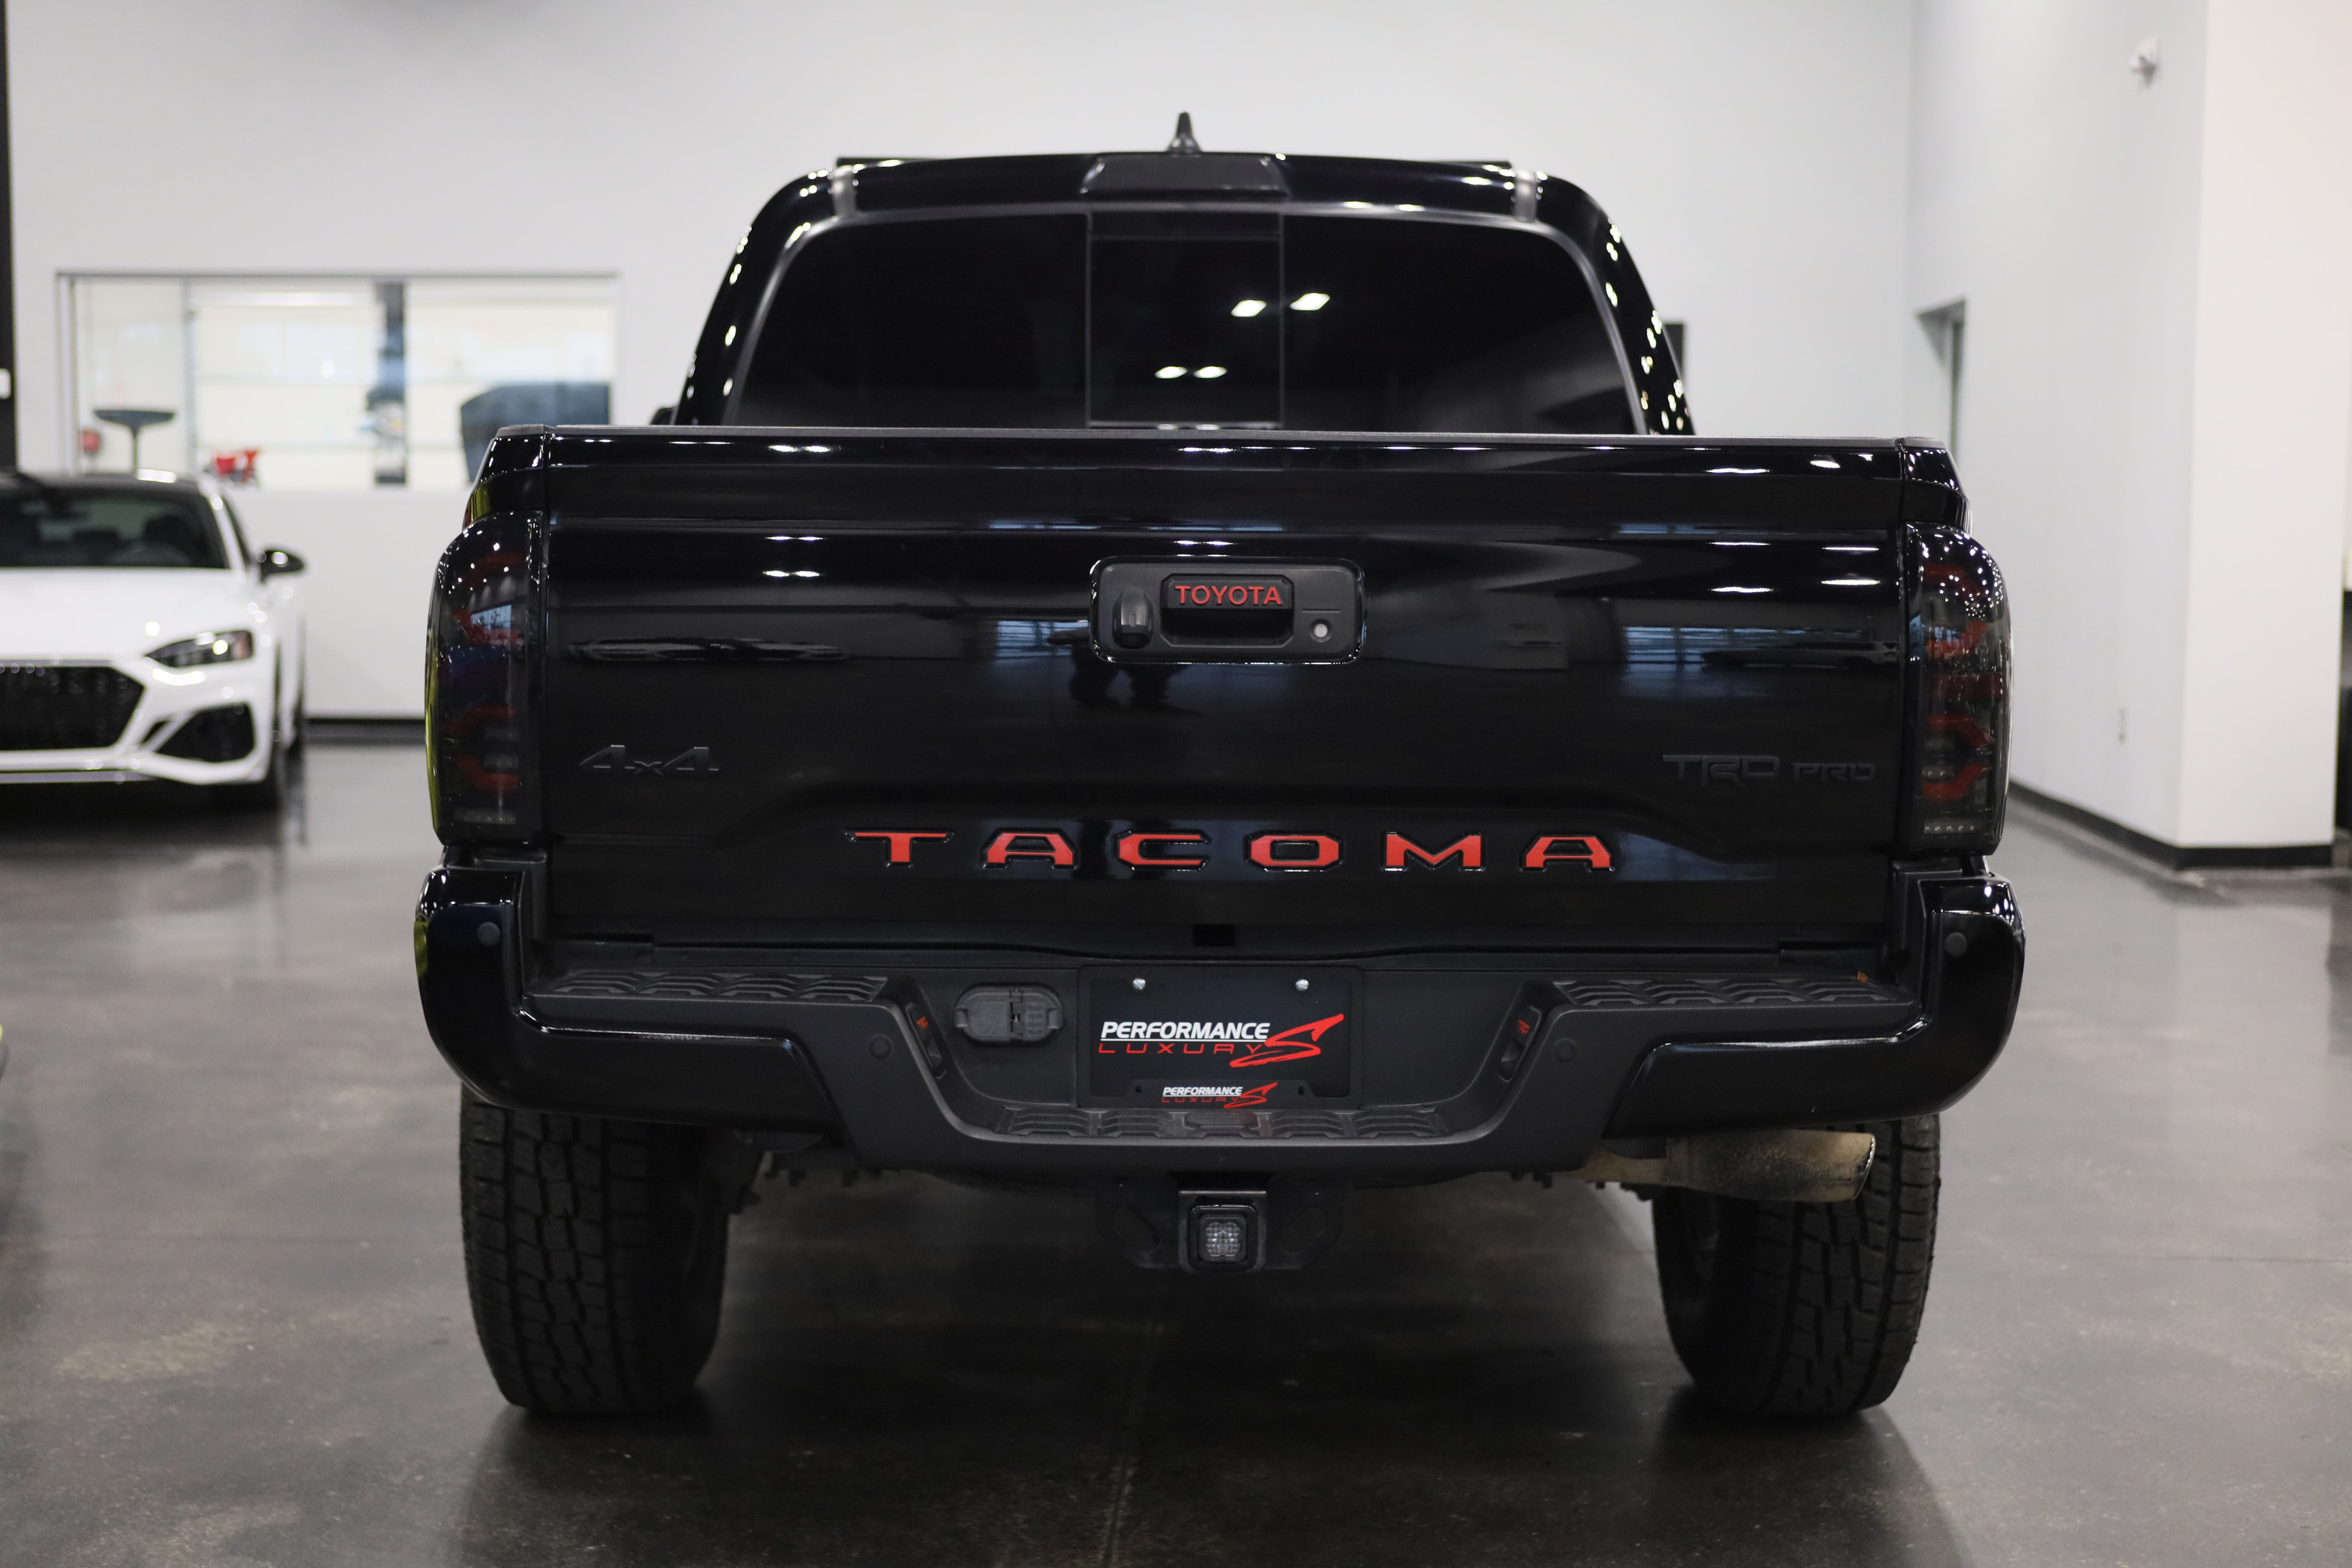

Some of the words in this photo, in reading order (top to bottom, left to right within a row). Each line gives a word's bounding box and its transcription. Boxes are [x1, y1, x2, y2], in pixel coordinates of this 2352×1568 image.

[1174, 585, 1282, 605] TOYOTA
[578, 744, 722, 780] 4x4
[1662, 754, 1780, 788] TRD
[1793, 762, 1876, 782] PRO
[847, 830, 1614, 871] TACOMA
[1101, 1021, 1270, 1040] PERFORMANCE
[1163, 1086, 1243, 1096] PERFORMANCE
